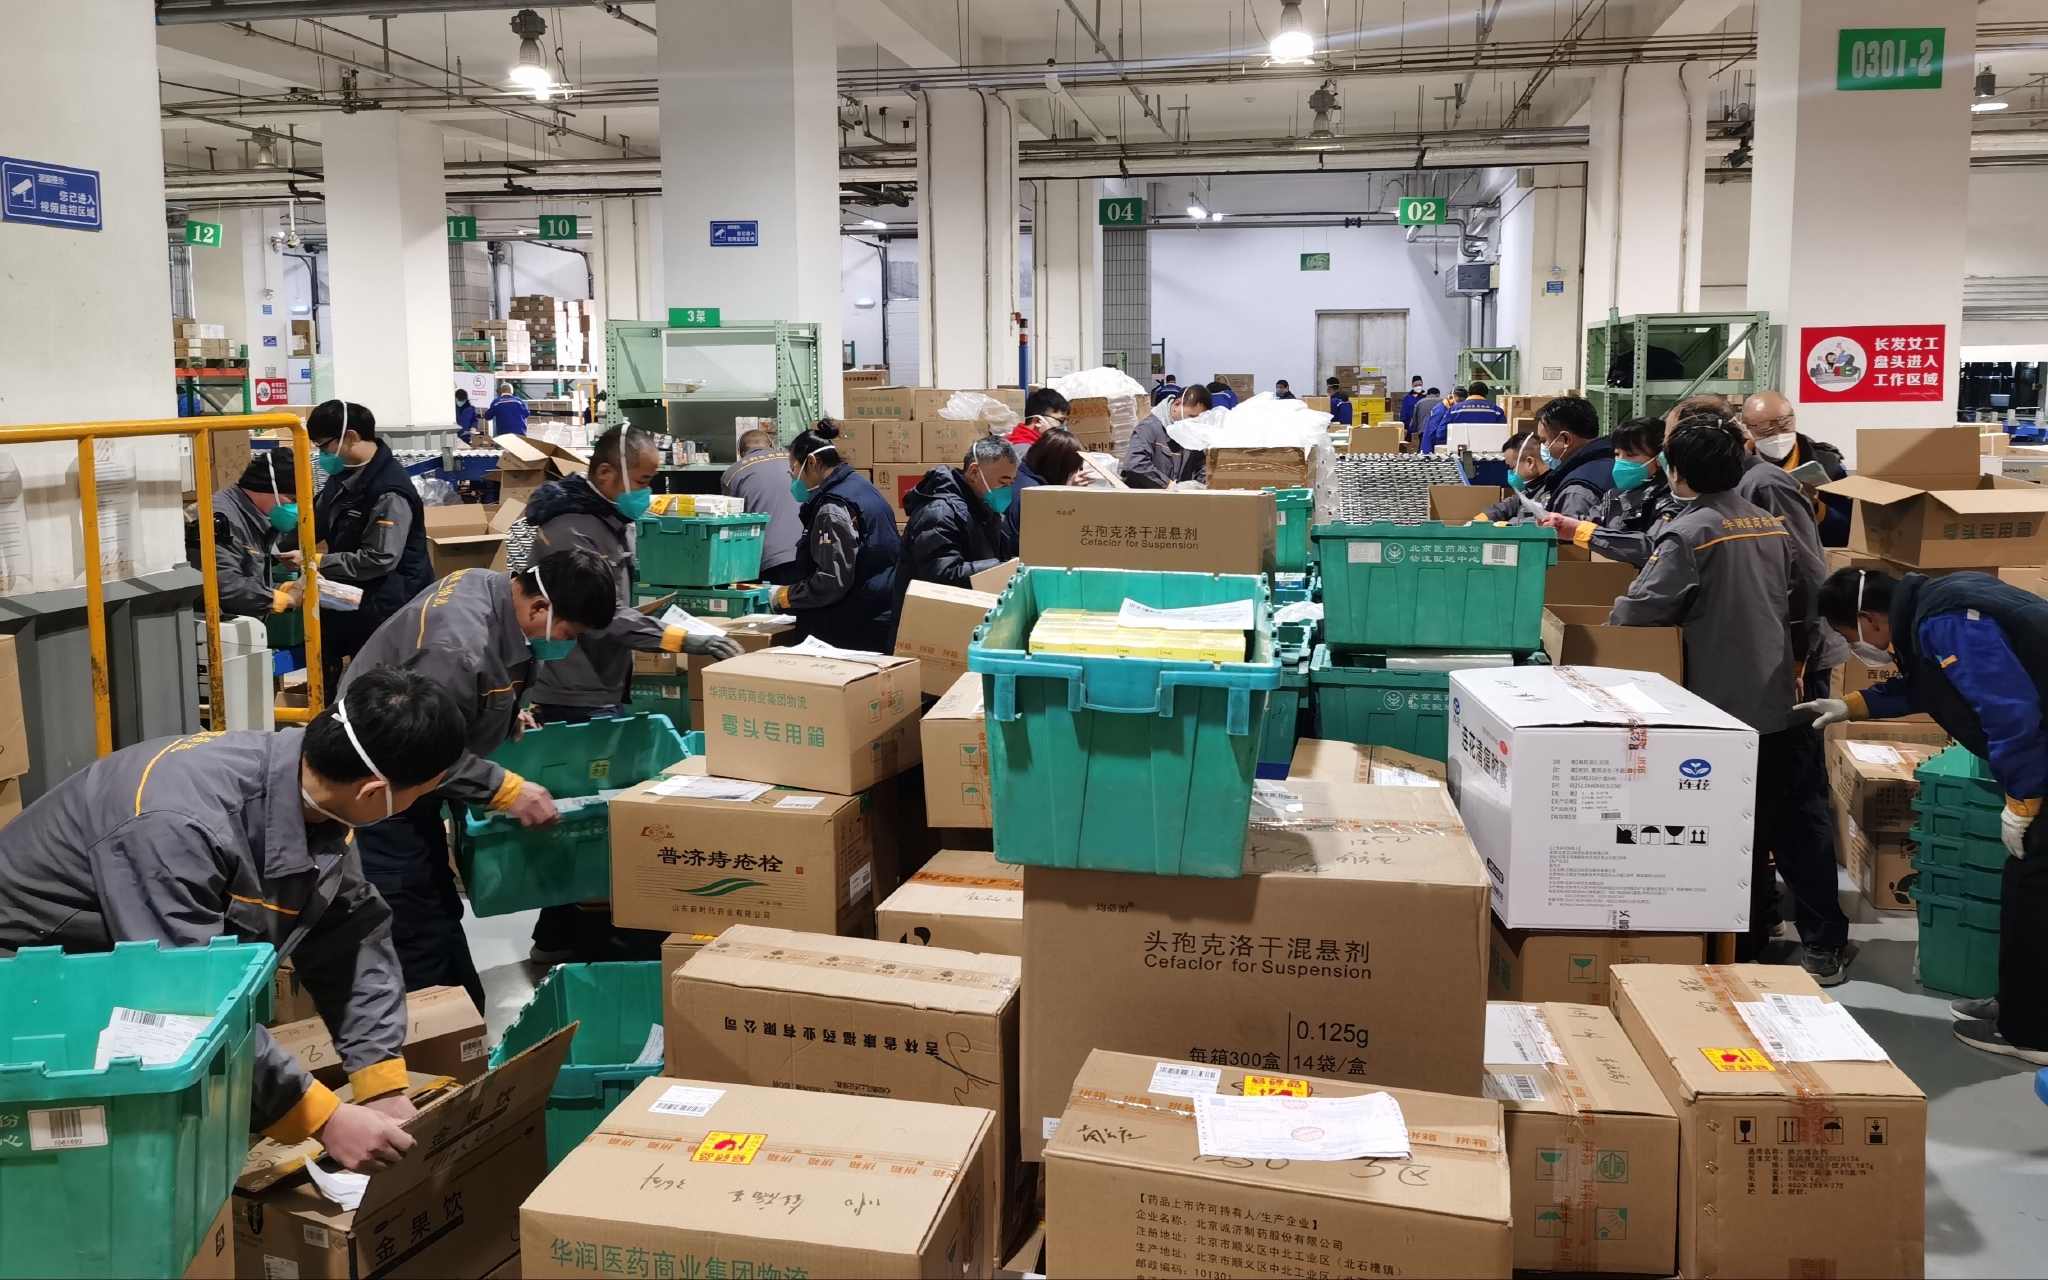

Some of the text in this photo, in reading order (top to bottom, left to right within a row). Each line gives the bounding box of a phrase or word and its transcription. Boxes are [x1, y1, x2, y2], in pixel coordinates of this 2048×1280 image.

[1851, 38, 1934, 79] 0301-2
[59, 190, 96, 205] 您已进入
[40, 201, 96, 218] 视频监控区域
[1107, 202, 1134, 220] 04
[1407, 203, 1436, 221] 02
[192, 226, 214, 243] 12
[448, 221, 469, 238] 11
[547, 219, 570, 236] 10
[687, 310, 705, 323] 3架
[1874, 338, 1939, 351] 长发女工
[1874, 356, 1939, 369] 盘头进入
[1873, 373, 1939, 387] 工作区域
[1081, 525, 1197, 540] 头孢克洛干混悬剂
[1081, 538, 1198, 549] Cefaclor for Suspension
[1409, 544, 1479, 553] 北京医药股份
[1409, 555, 1480, 564] 物流配送中心
[709, 685, 807, 709] 华润医药商业集团物流
[722, 714, 825, 748] 零头专用箱
[657, 846, 784, 873] 普济痔疮栓
[672, 903, 771, 920] 山东新时代药业有限公司
[1144, 930, 1370, 963] 头孢克洛干混悬剂
[1144, 953, 1372, 979] Cefaclor for Suspension
[724, 1016, 939, 1055] 吉林省康福药业有限公司
[1296, 1020, 1369, 1048] 0.125g
[1189, 1047, 1368, 1076] 每箱300盒 14袋/盒
[430, 1086, 515, 1151] 金果饮
[1455, 1136, 1488, 1147] 拼箱
[1140, 1193, 1318, 1230] 【药品上市许可持有人/生产企业】
[375, 1191, 463, 1266] 金果饮
